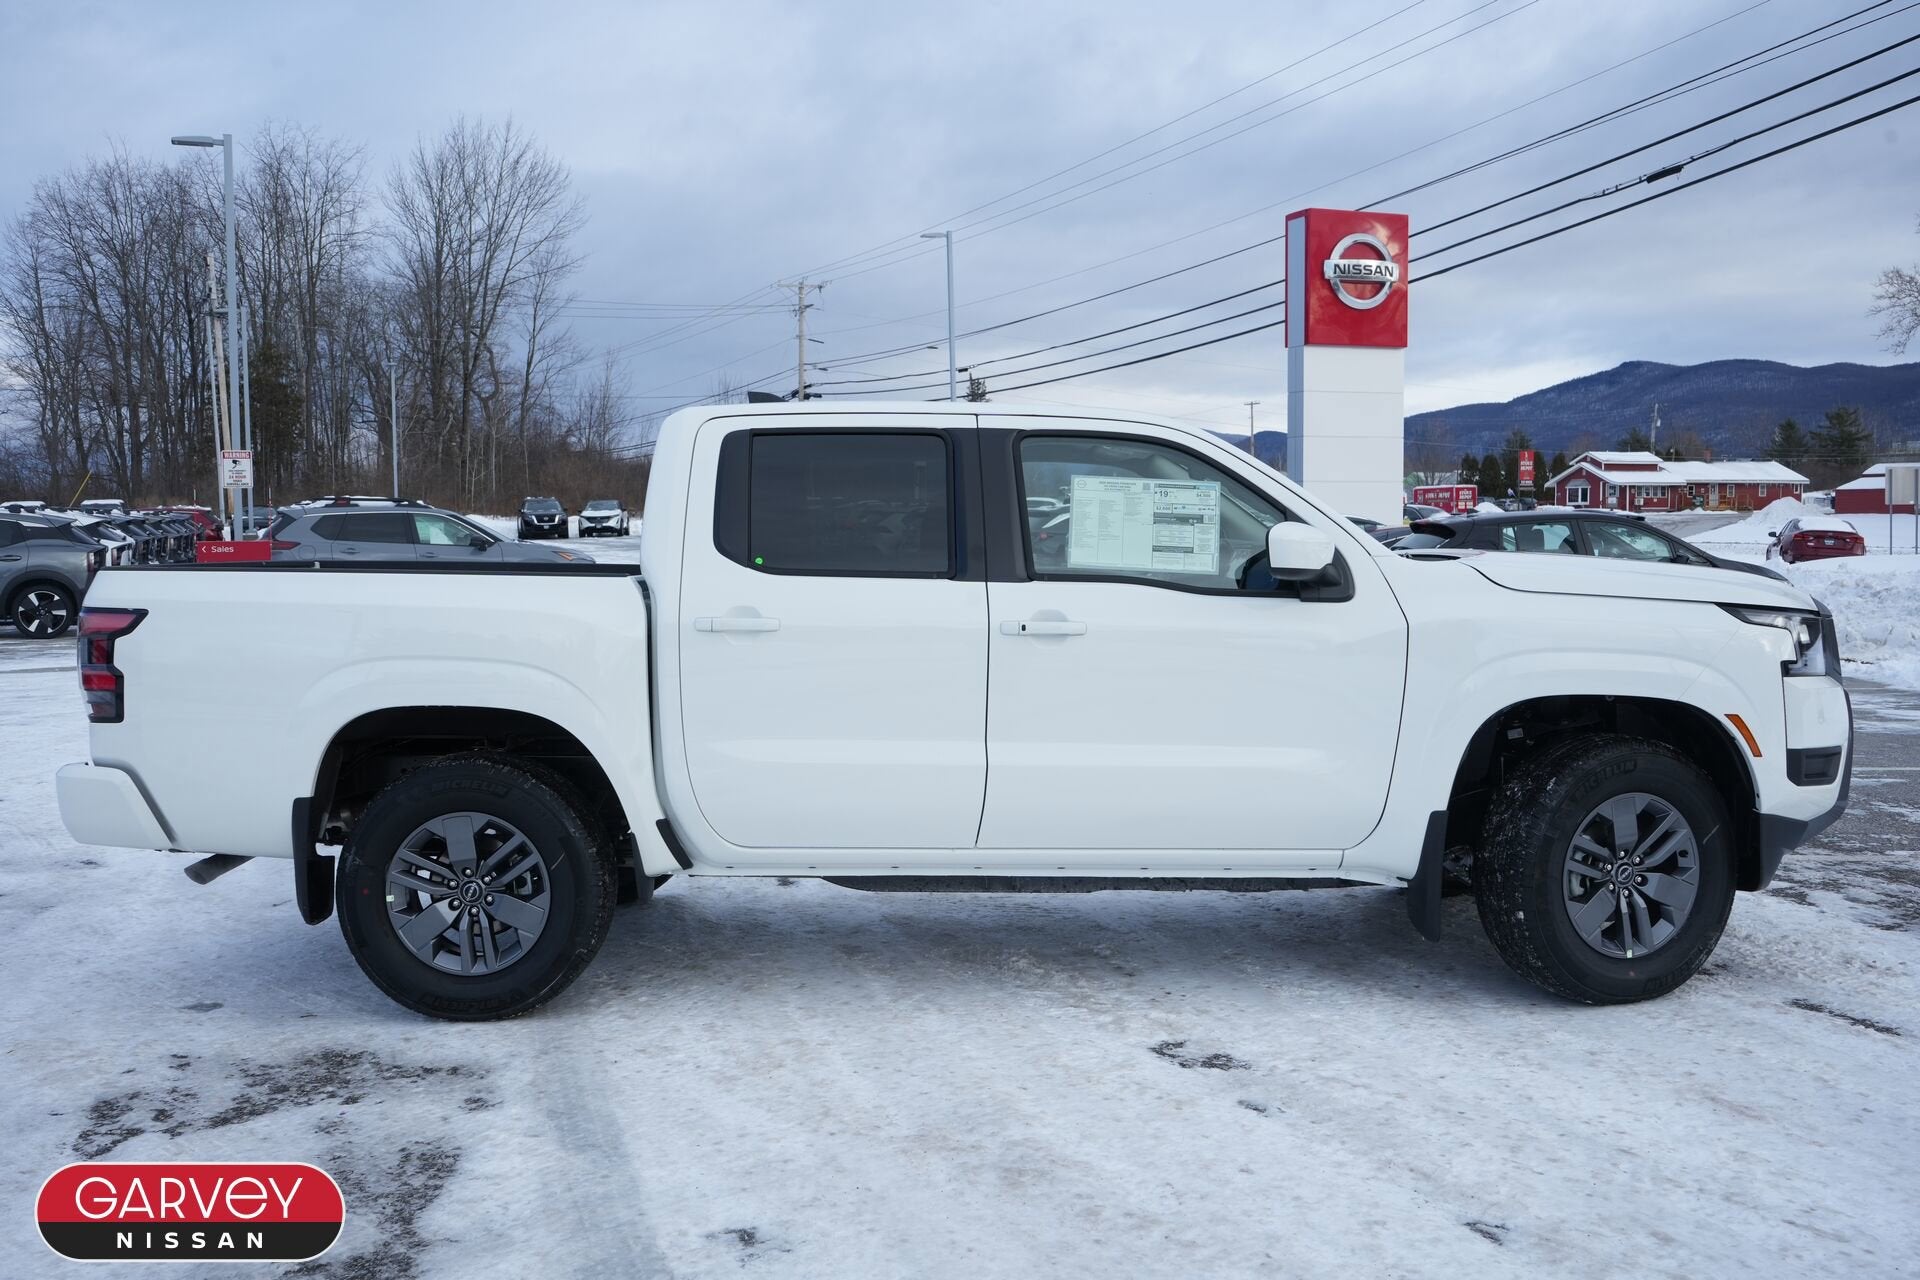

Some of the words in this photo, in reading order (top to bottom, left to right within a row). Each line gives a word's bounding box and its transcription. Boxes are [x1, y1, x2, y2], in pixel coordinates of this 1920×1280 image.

[1333, 263, 1394, 278] NISSAN
[1159, 490, 1169, 498] 19
[211, 545, 234, 553] Sales
